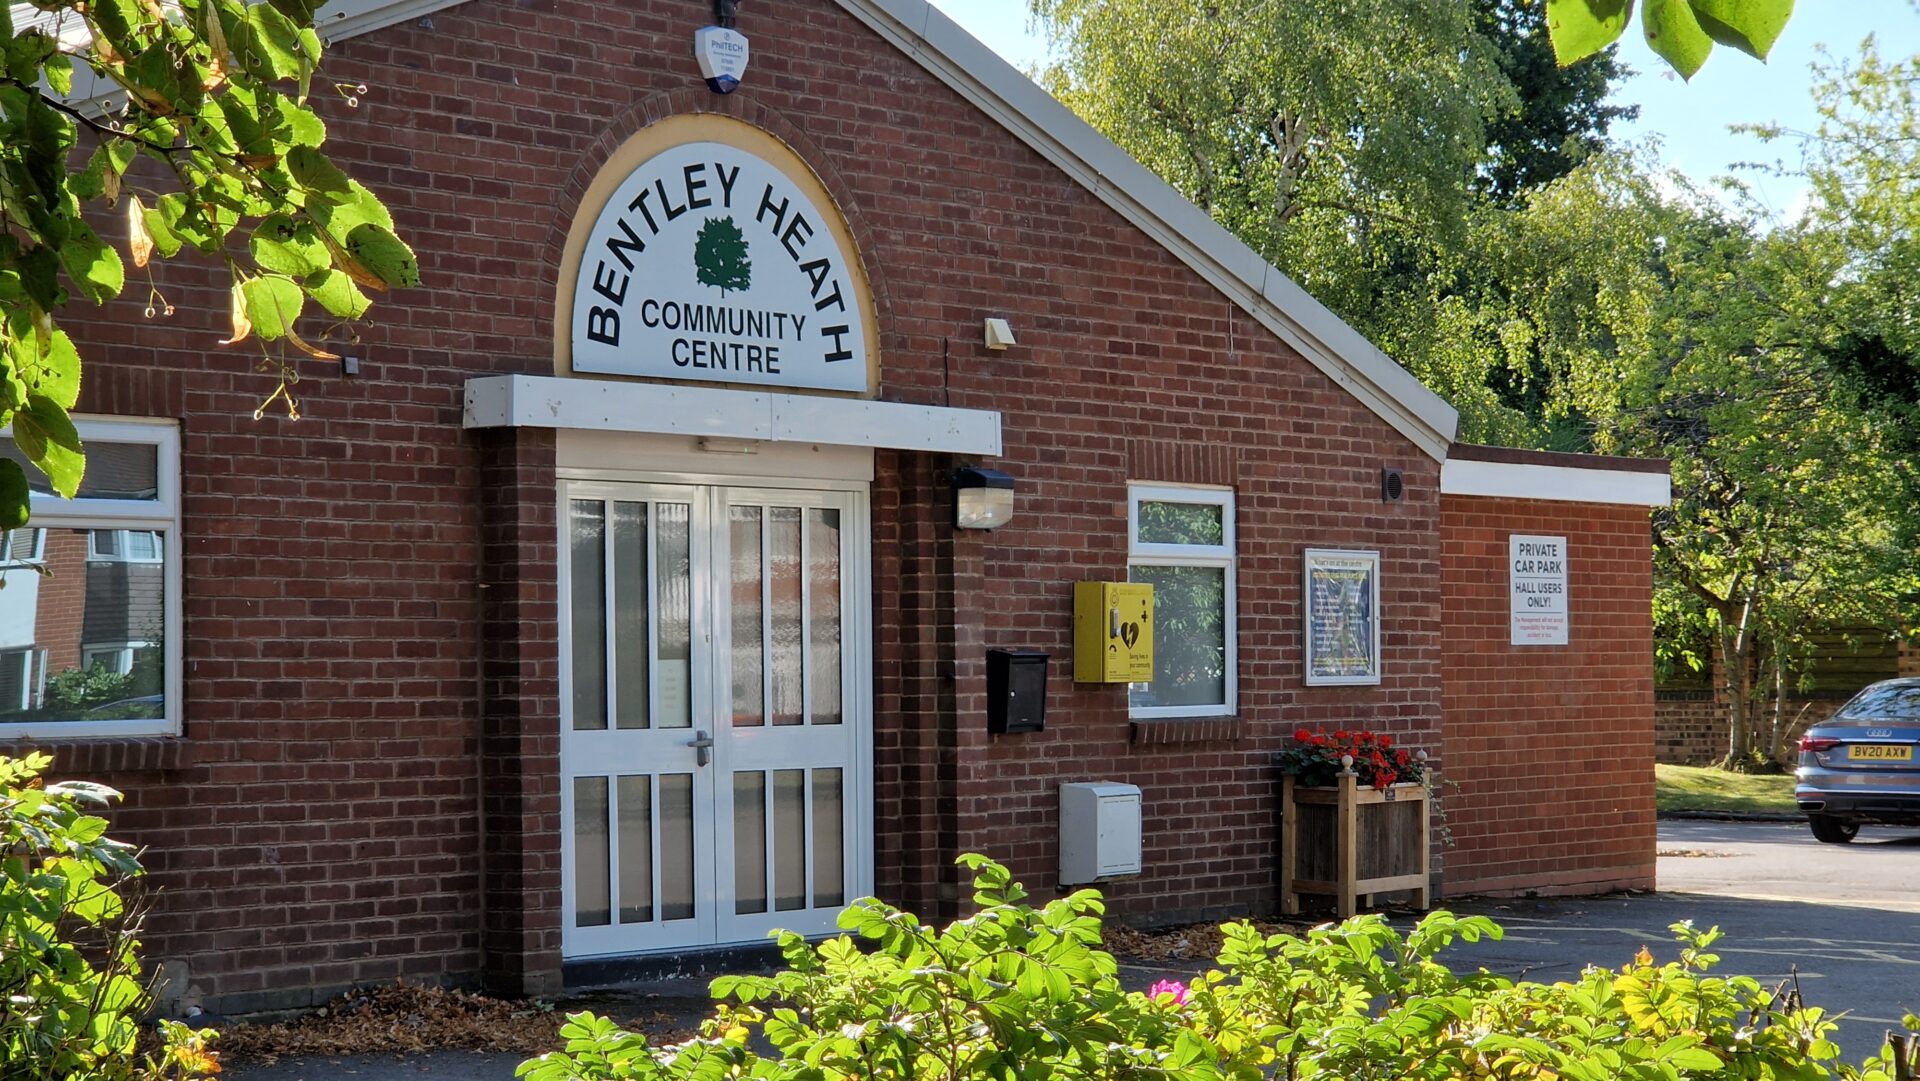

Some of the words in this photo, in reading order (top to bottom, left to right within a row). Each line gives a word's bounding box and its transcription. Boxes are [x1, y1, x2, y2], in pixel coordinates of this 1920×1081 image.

[587, 162, 740, 347] BENTLEY
[755, 183, 853, 363] HEATH
[641, 299, 806, 341] COMMUNITY
[671, 338, 780, 374] CENTRE
[1519, 543, 1557, 557] PRIVATE
[1515, 560, 1535, 573] CAR
[1537, 561, 1562, 574] PARK
[1515, 582, 1536, 593] HALL
[1538, 583, 1562, 594] USERS
[1527, 597, 1551, 607] ONLY!
[1854, 746, 1883, 757] BV20
[1885, 746, 1907, 757] AXW
